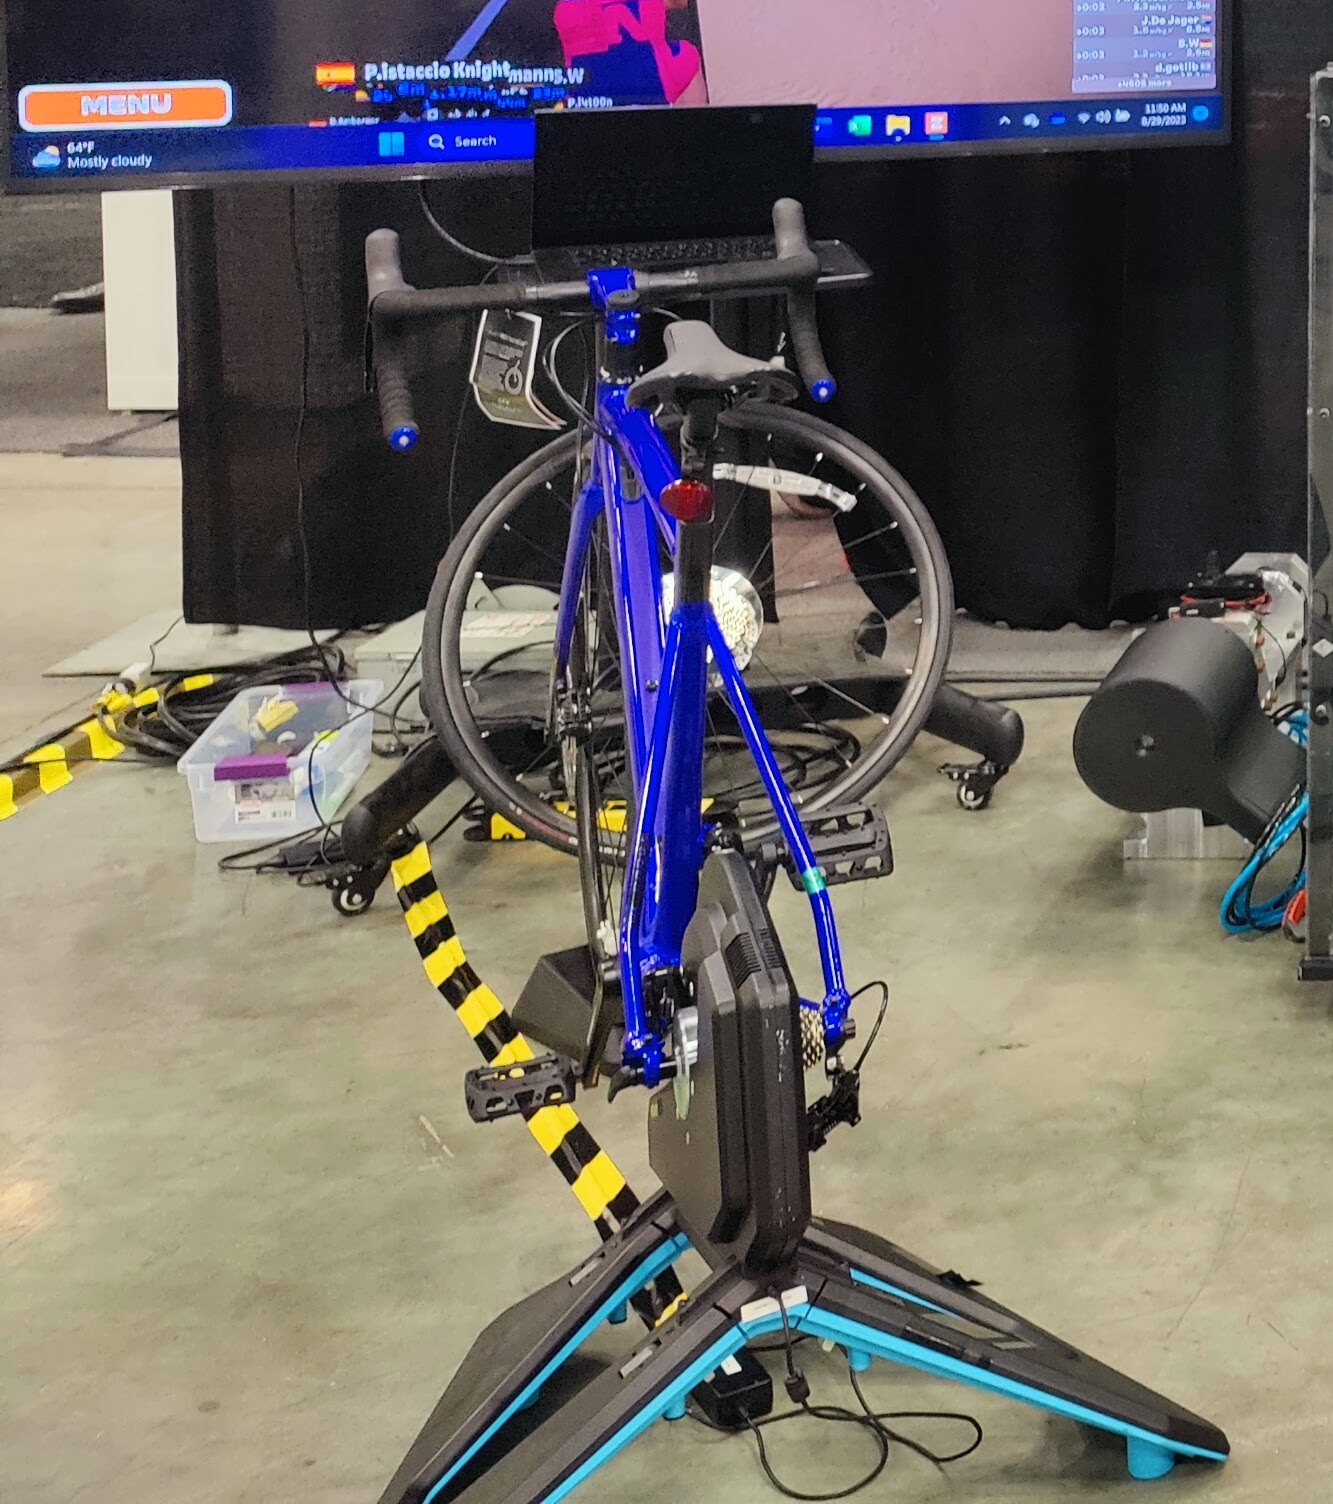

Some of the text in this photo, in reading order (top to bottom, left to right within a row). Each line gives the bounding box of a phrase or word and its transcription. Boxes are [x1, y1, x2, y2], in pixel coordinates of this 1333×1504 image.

[452, 61, 510, 81] Knight
[79, 92, 173, 116] MENU
[1168, 102, 1187, 114] AM
[67, 142, 95, 156] 64°F
[454, 132, 498, 150] Search
[67, 152, 152, 170] Mostly cloudy
